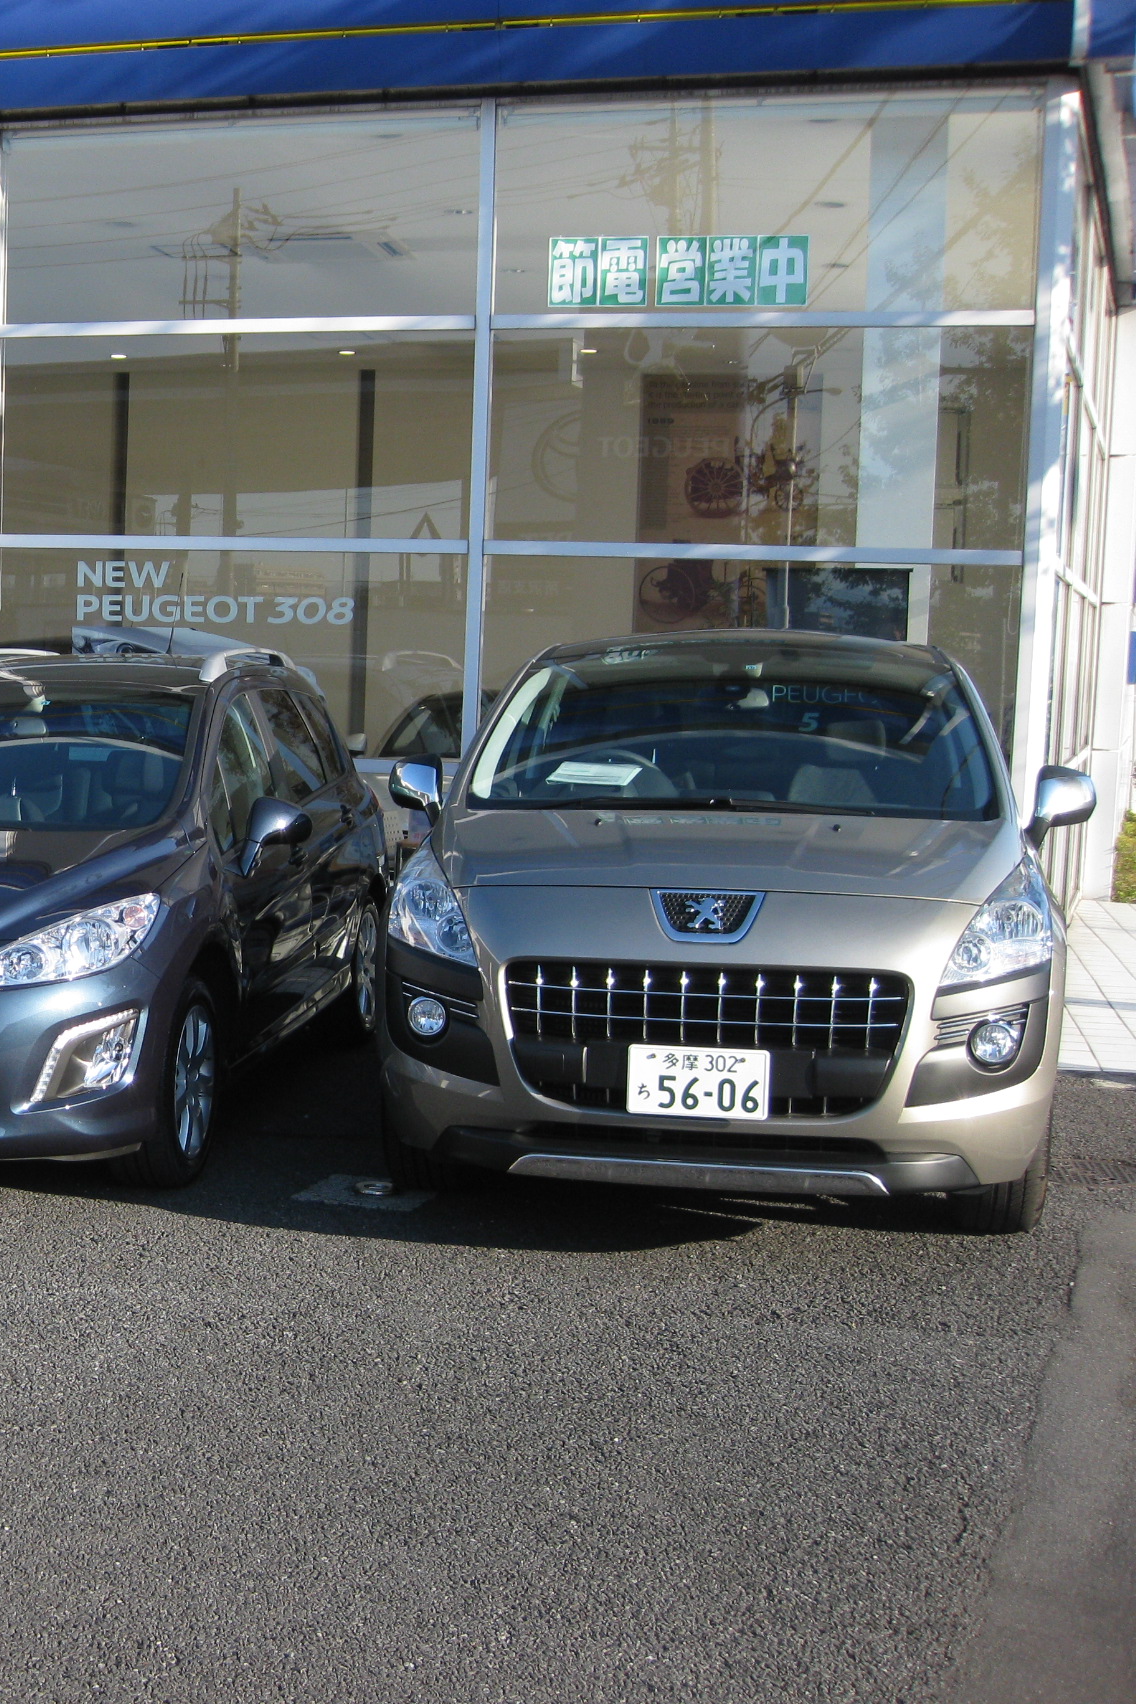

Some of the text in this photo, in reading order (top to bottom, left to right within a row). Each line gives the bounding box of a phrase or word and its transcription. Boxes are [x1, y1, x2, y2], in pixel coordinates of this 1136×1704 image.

[551, 237, 805, 304] 節電 営業中
[76, 560, 170, 588] NEW
[76, 594, 355, 625] PEUGEOT 308
[662, 1052, 739, 1073] 多摩 302
[637, 1074, 760, 1114] ち 56-06
